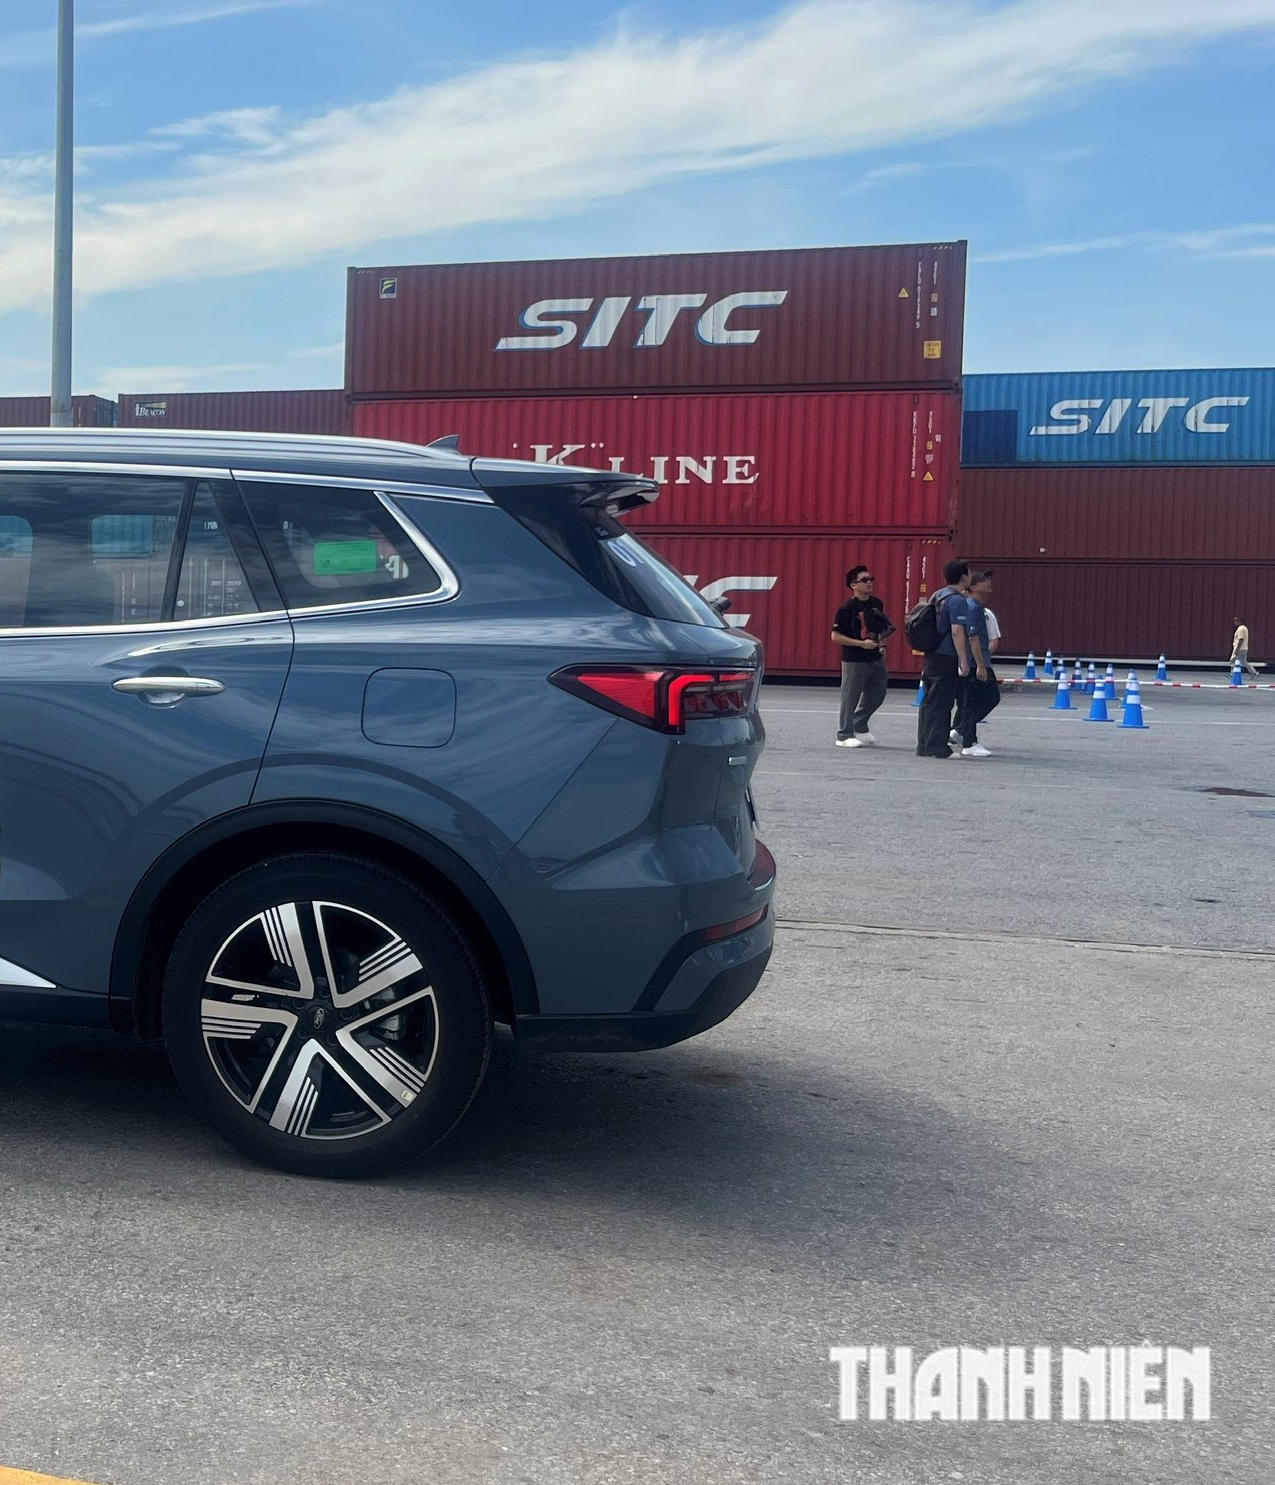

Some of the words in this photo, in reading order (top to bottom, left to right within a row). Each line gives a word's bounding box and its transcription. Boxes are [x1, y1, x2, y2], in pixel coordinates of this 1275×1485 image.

[494, 290, 788, 351] SITC
[1030, 396, 1249, 435] SITC
[608, 455, 759, 484] LINE
